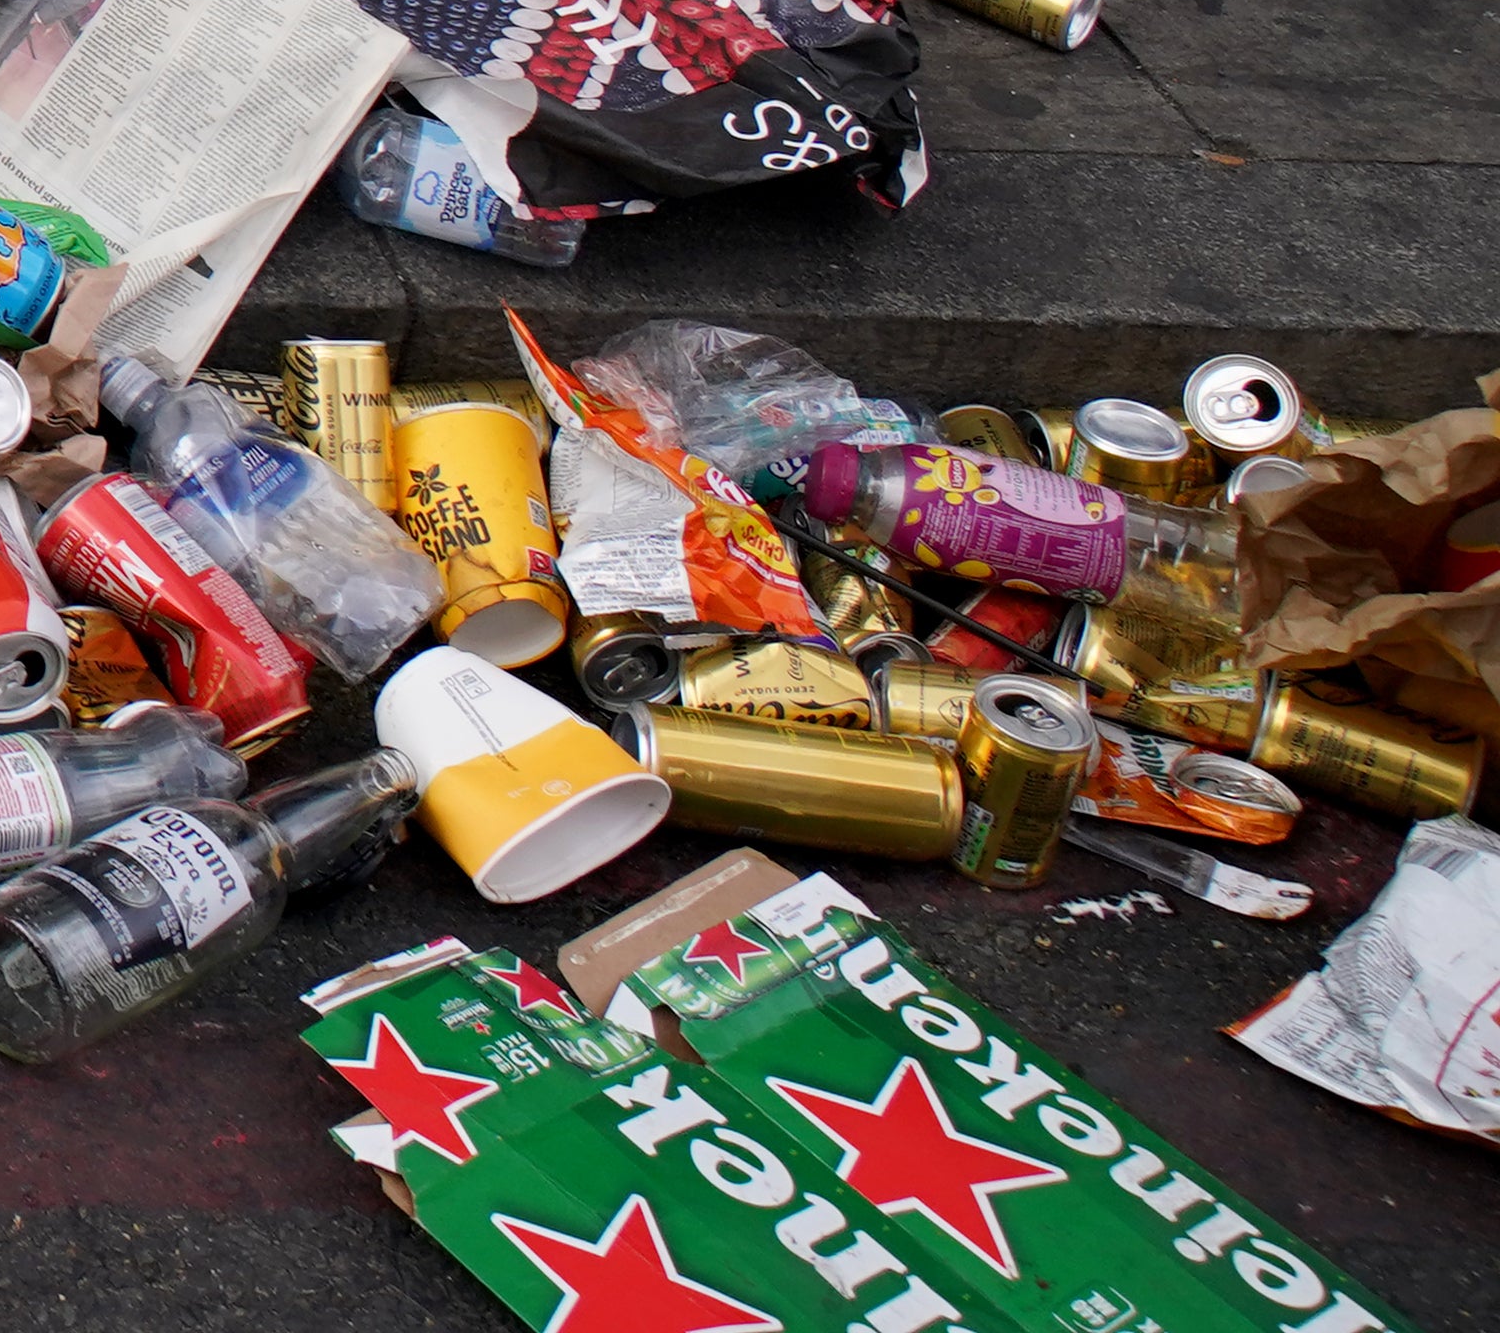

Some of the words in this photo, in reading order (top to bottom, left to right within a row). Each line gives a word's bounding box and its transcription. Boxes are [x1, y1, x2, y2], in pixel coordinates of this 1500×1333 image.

[441, 161, 466, 224] Princes
[454, 175, 474, 220] Gate
[951, 460, 963, 487] Lipton
[405, 484, 479, 541] COFFEE
[422, 516, 492, 564] SLAND
[742, 524, 785, 563] CHIPS
[140, 810, 237, 898] Corona
[150, 830, 201, 881] Extra
[508, 1041, 550, 1074] 15
